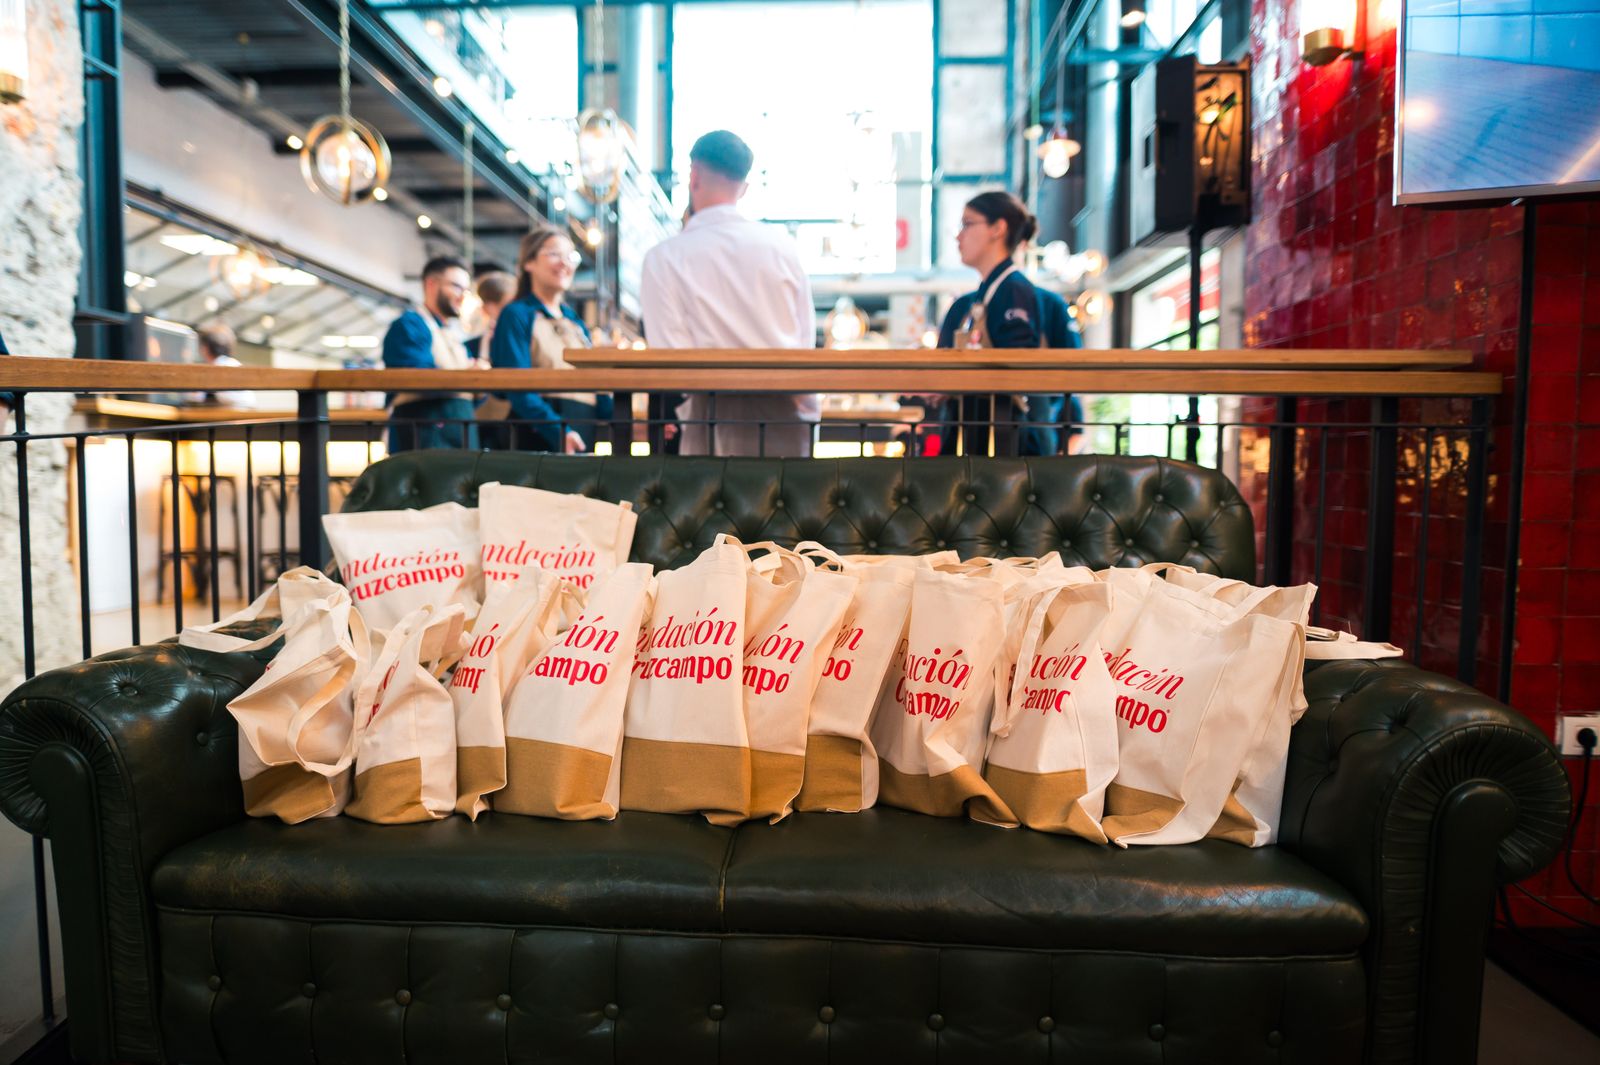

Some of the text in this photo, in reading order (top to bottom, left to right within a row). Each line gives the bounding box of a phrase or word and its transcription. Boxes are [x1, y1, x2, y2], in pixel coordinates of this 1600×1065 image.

[349, 563, 465, 606] ruzcampo
[563, 614, 619, 653] ión
[533, 655, 608, 686] ampo
[631, 655, 732, 684] ruzcampo
